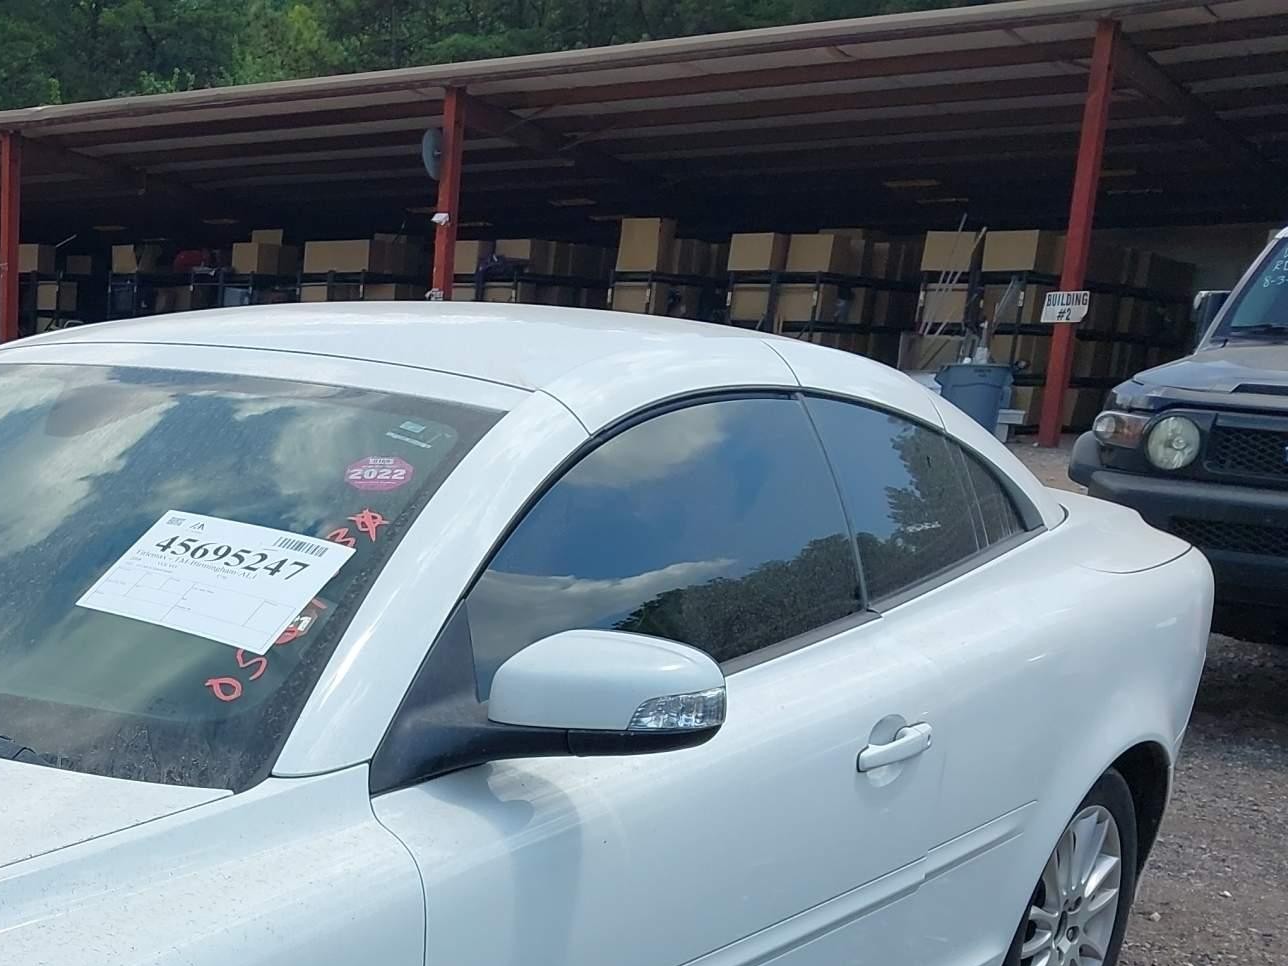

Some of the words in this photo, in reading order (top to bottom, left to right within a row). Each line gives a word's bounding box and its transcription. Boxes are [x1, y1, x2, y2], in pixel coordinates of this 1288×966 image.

[1046, 293, 1089, 306] BUILDING
[1057, 308, 1072, 321] #2
[349, 468, 407, 480] 2022
[155, 535, 310, 581] 45695247
